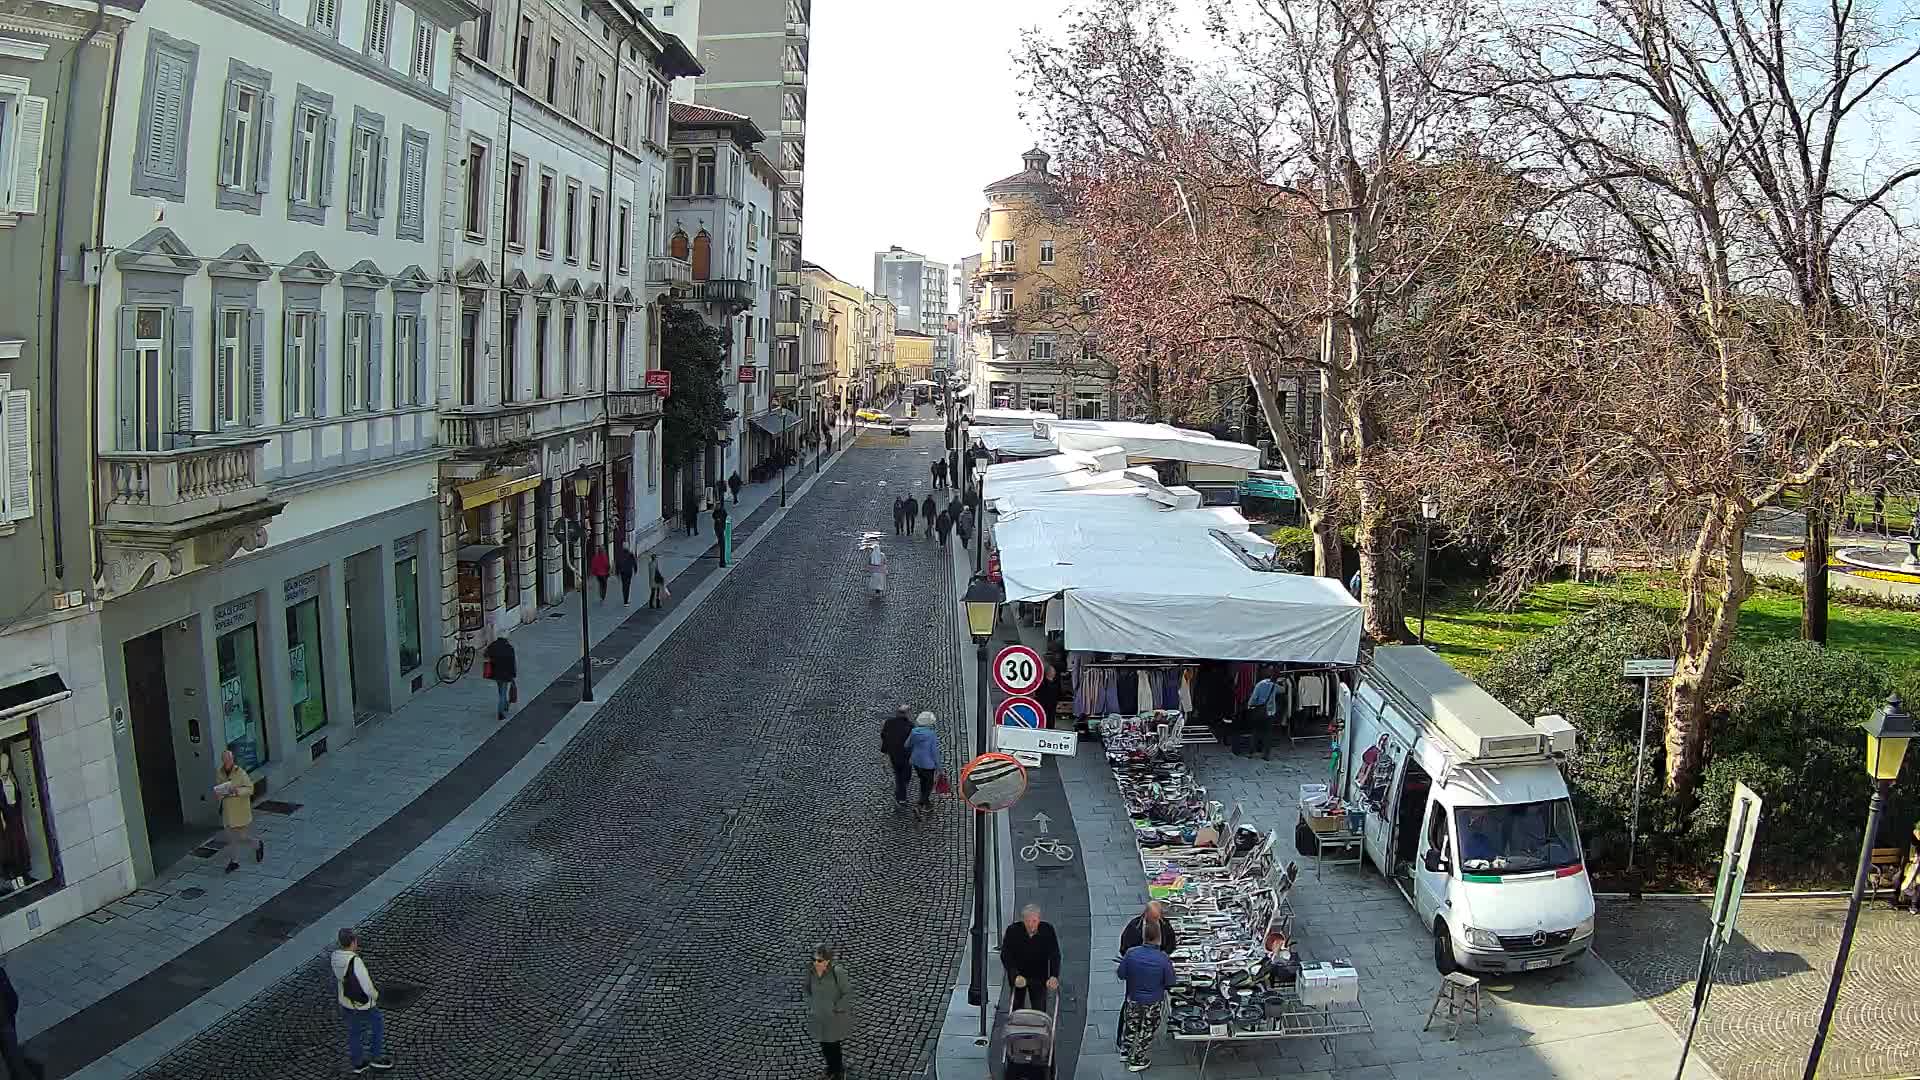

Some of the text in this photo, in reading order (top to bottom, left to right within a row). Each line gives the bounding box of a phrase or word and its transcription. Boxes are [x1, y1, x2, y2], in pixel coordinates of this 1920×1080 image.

[1006, 660, 1032, 681] 30
[224, 680, 240, 702] 130
[1039, 739, 1070, 751] Dante
